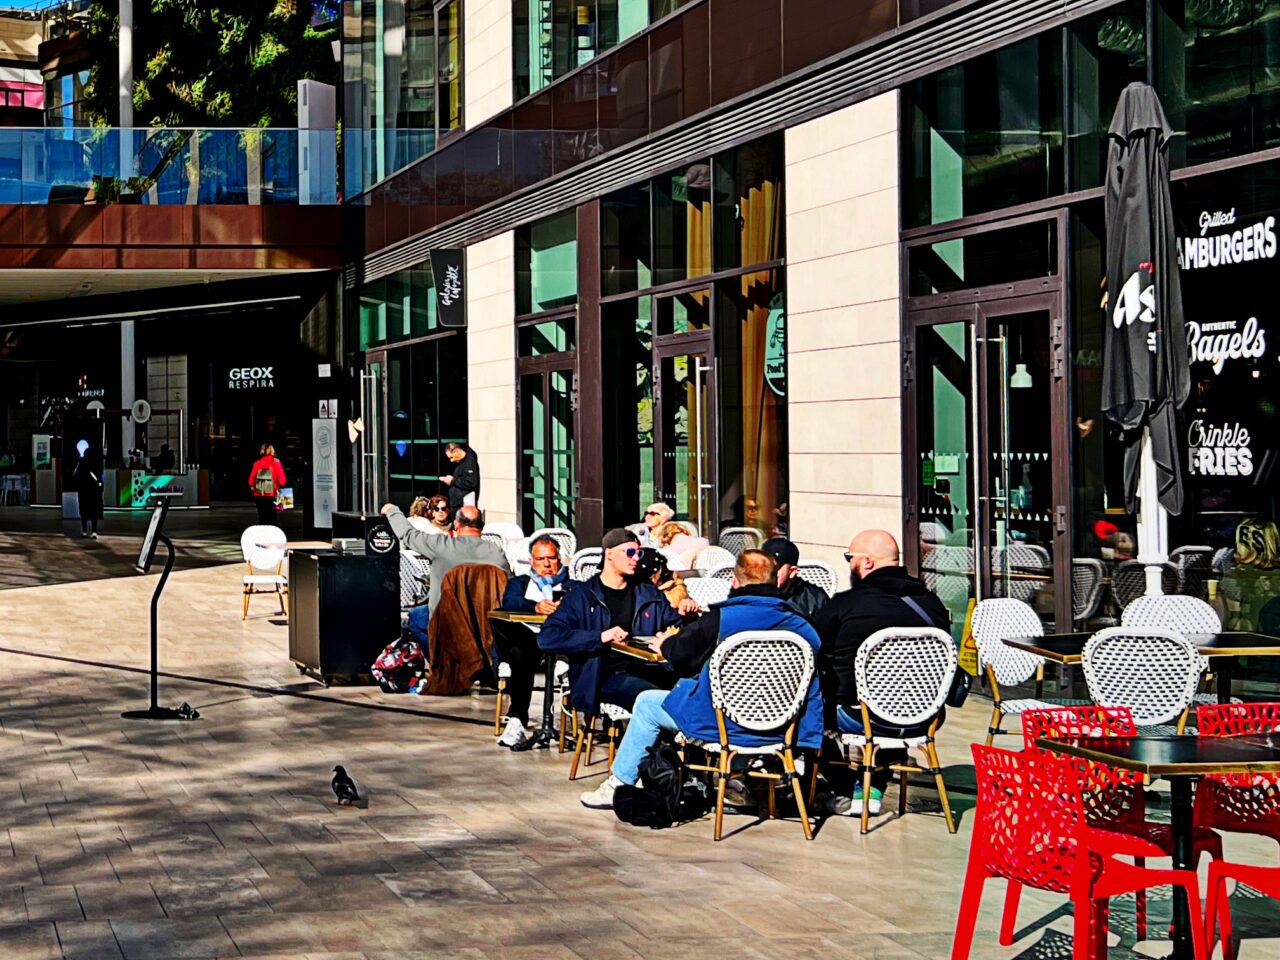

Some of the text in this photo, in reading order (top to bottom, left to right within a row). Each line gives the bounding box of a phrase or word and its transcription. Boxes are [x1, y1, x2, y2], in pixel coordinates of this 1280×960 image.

[1199, 207, 1237, 236] Grilled
[1176, 216, 1277, 270] AMBURGERS
[1201, 320, 1237, 332] AUTHENTIC
[1184, 317, 1266, 376] Bagels
[228, 380, 275, 390] RESPIRA
[229, 366, 275, 380] GEOX
[1188, 419, 1251, 447] Crinkle
[1188, 447, 1253, 476] FRIES
